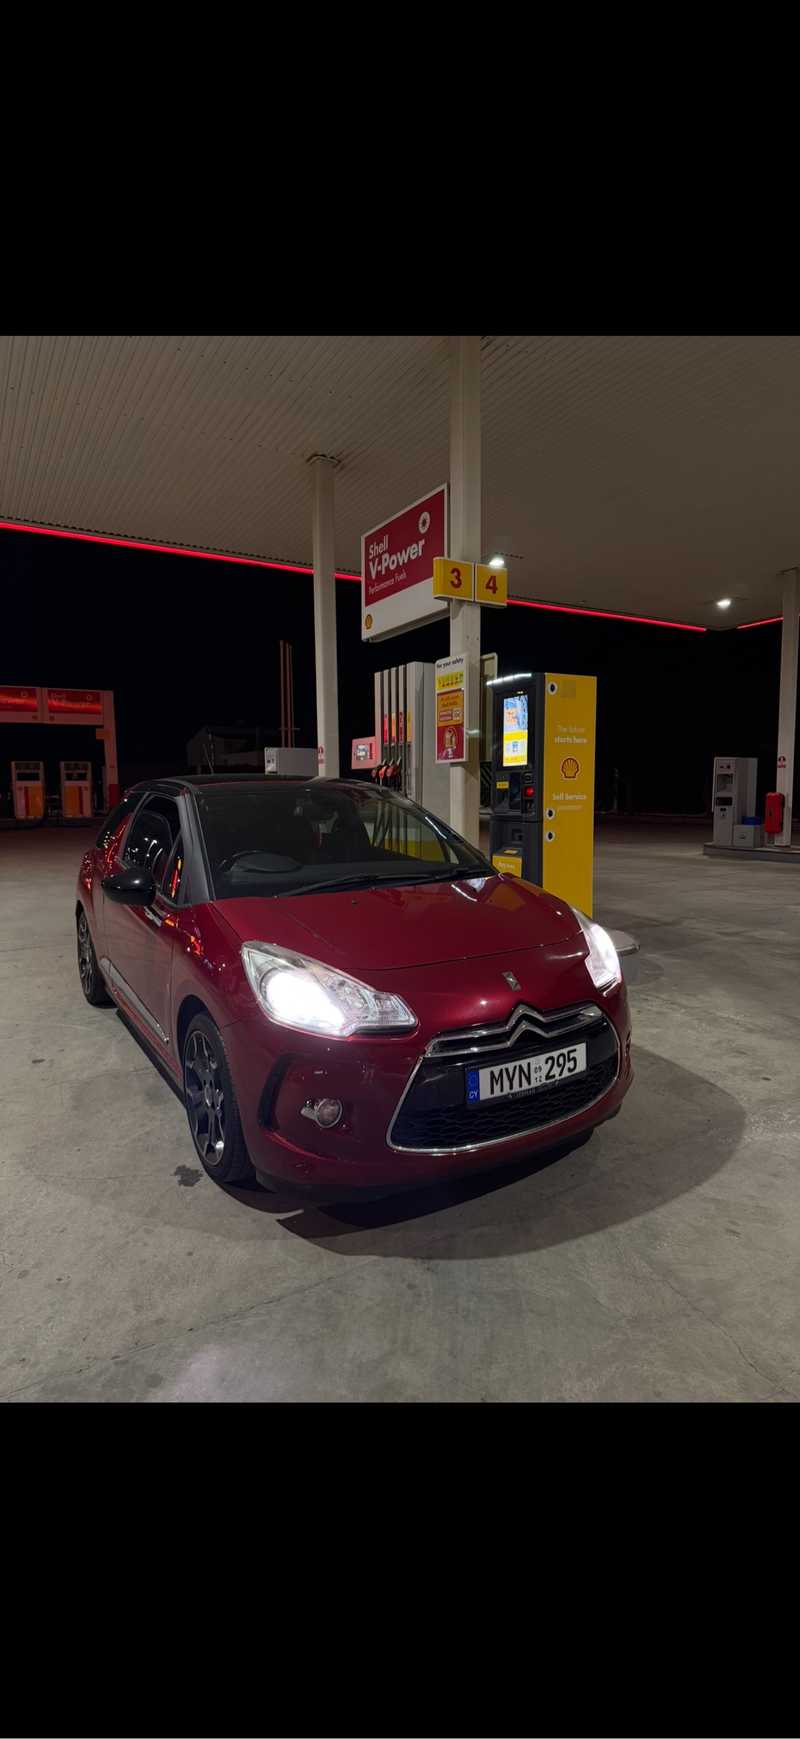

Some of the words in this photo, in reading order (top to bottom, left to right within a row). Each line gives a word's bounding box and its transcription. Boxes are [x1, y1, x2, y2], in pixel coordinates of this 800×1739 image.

[369, 535, 388, 559] Shell
[369, 538, 425, 580] V-Power
[450, 567, 462, 589] 3
[485, 575, 498, 595] 4
[489, 1062, 531, 1096] MYN
[545, 1049, 577, 1081] 295
[469, 1090, 478, 1099] CY
